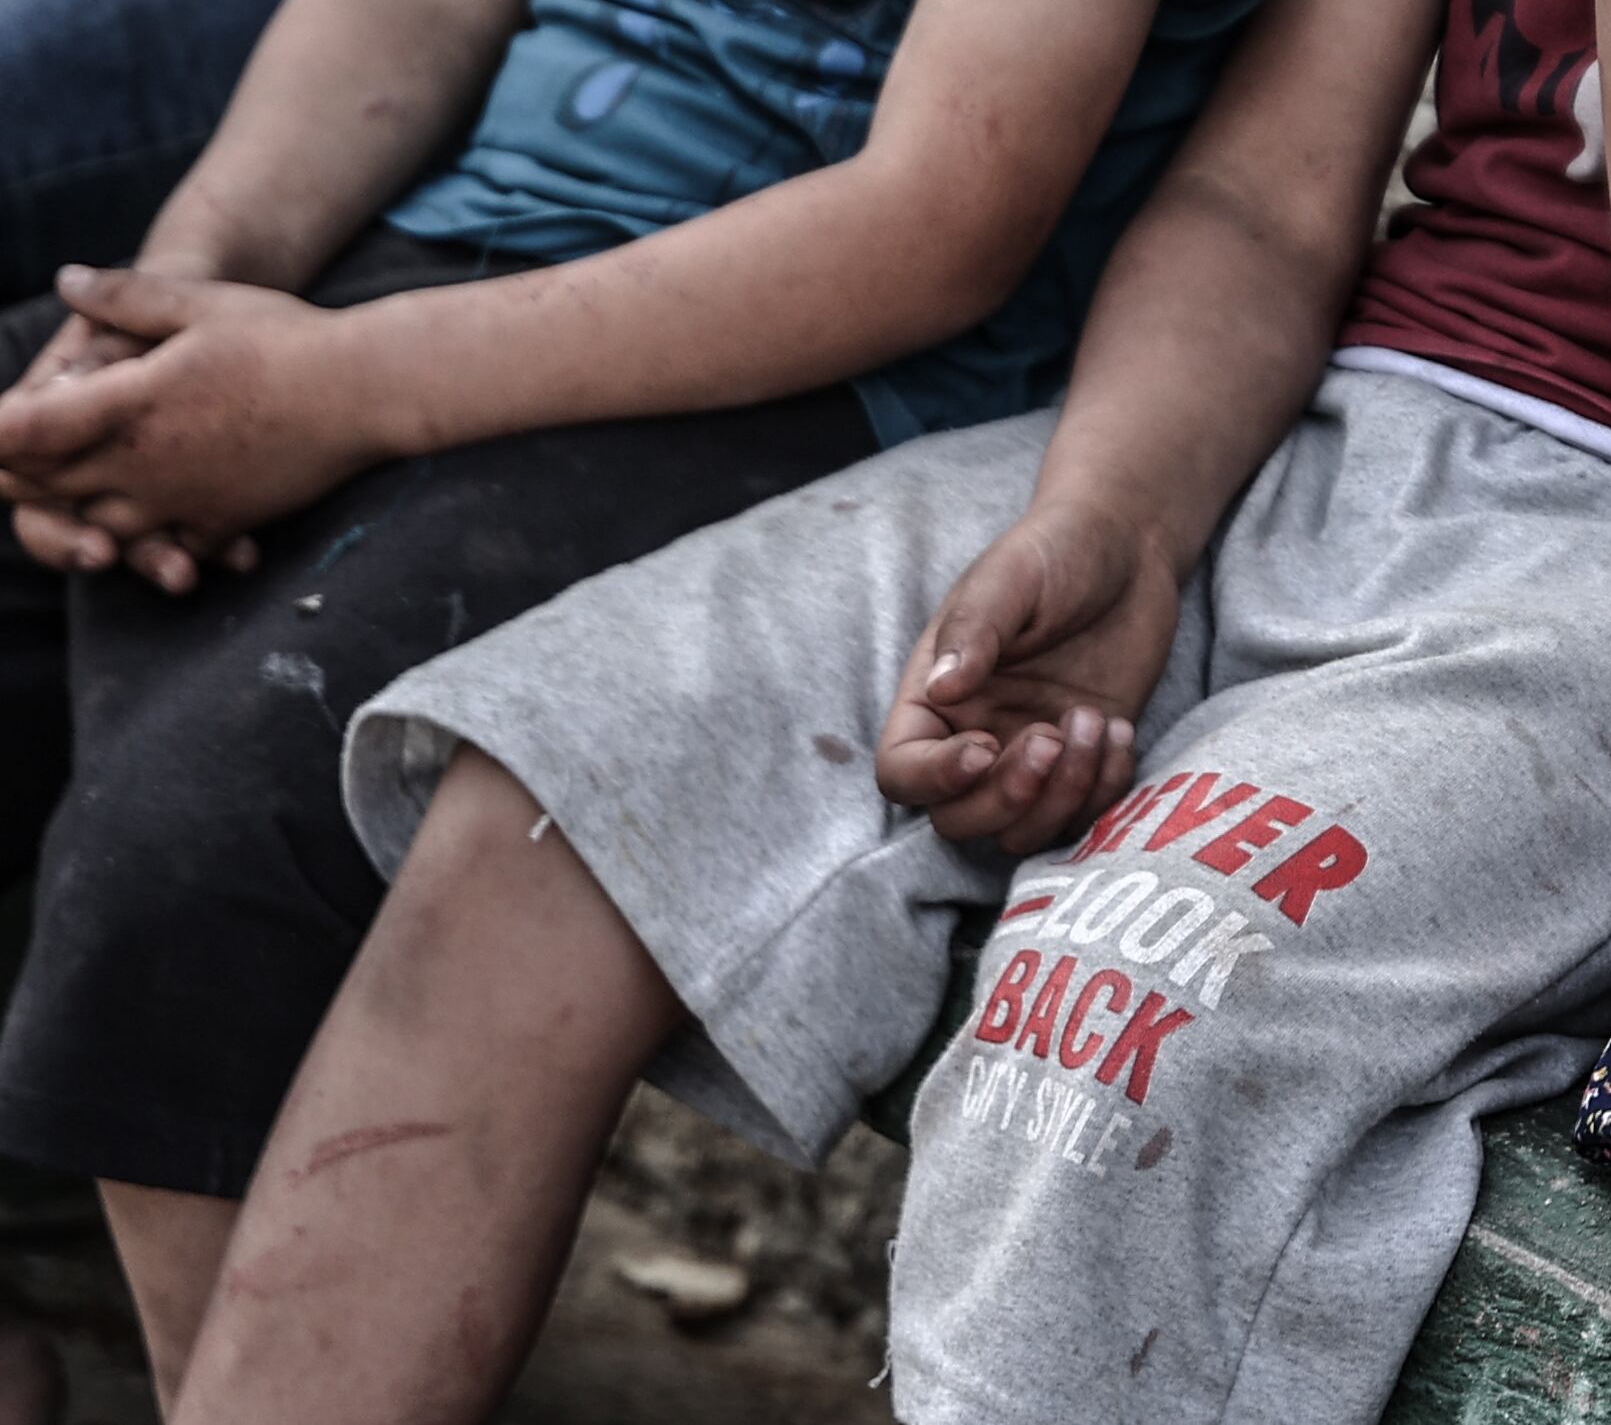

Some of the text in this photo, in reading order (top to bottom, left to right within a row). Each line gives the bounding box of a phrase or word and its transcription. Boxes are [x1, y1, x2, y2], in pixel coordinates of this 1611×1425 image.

[1036, 869, 1276, 1011] LOOK
[975, 949, 1197, 1106] BACK
[1027, 1077, 1133, 1177] STYLE
